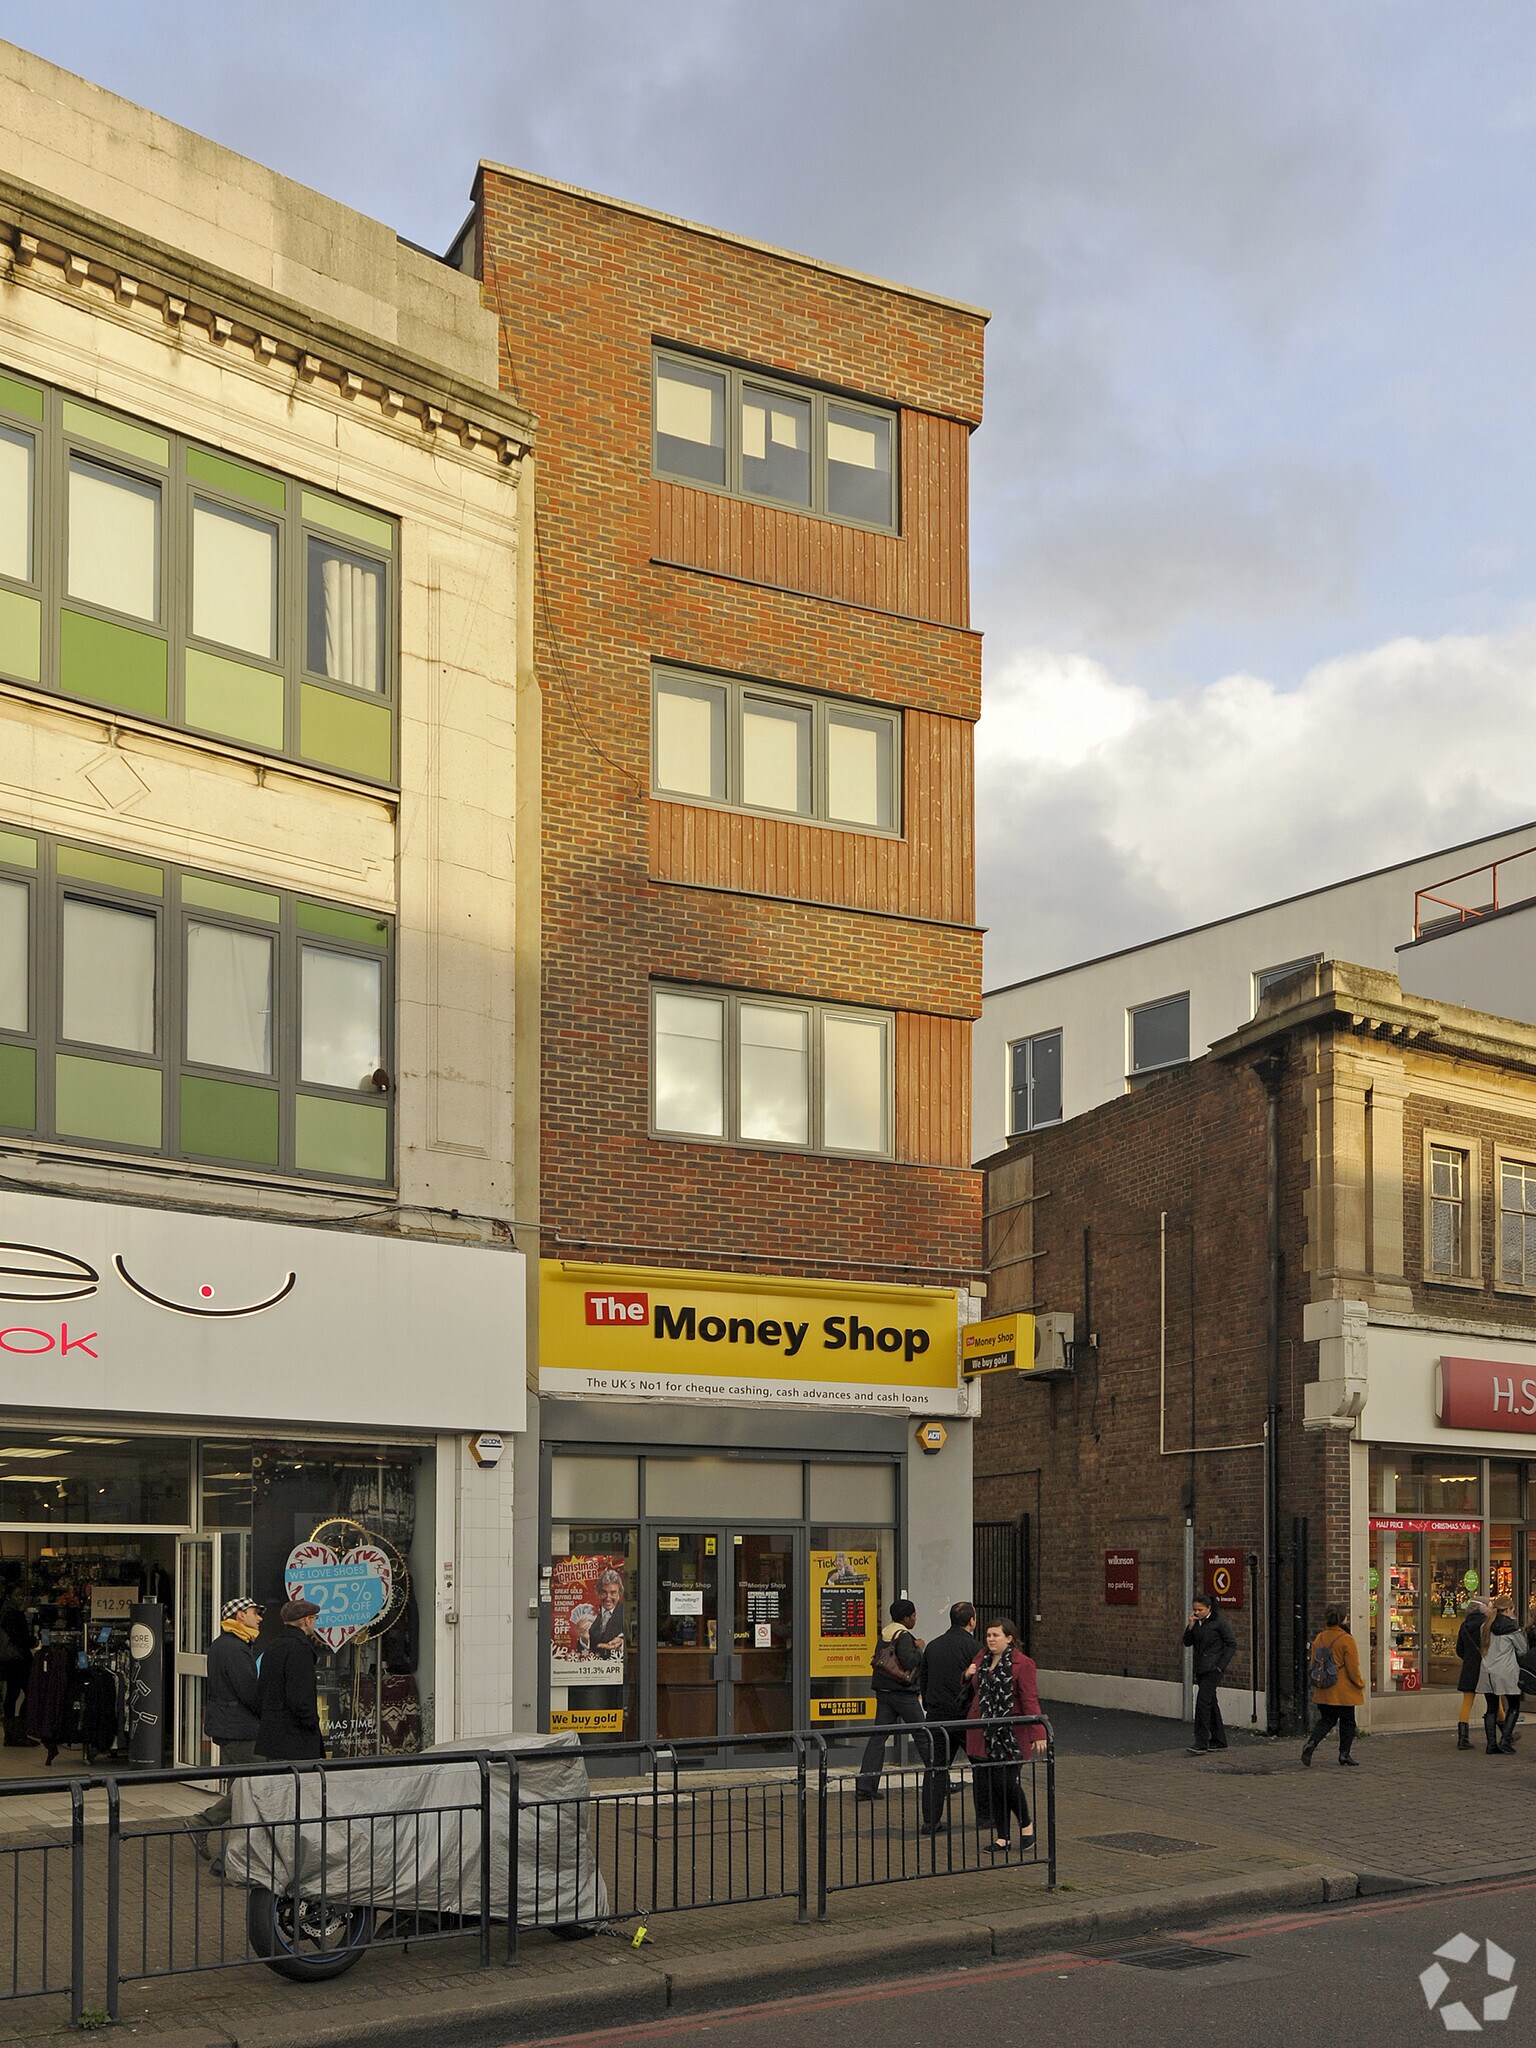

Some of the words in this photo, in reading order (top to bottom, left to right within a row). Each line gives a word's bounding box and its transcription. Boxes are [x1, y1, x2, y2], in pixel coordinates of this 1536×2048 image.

[591, 1297, 645, 1320] The
[655, 1305, 809, 1356] Money
[823, 1316, 930, 1362] Shop
[975, 1337, 996, 1347] Money
[998, 1333, 1014, 1343] Shop
[972, 1360, 981, 1369] We
[982, 1358, 993, 1368] buy
[994, 1354, 1007, 1367] gold
[587, 1378, 607, 1388] The
[640, 1380, 661, 1391] No1
[666, 1381, 682, 1391] for
[686, 1382, 726, 1395] cheque
[729, 1385, 772, 1398] cashing,
[776, 1387, 799, 1397] cash
[803, 1388, 851, 1400] advances
[854, 1391, 874, 1401] and
[877, 1392, 899, 1402] cash
[902, 1394, 929, 1404] loans
[928, 1430, 941, 1440] ADT
[1432, 1522, 1459, 1530] CHRISTMAS
[1108, 1556, 1134, 1565] wilkinson
[1209, 1555, 1236, 1565] wilkinson
[290, 1571, 305, 1579] WE
[308, 1568, 331, 1578] LOVE
[333, 1565, 365, 1576] SHOES
[556, 1561, 599, 1573] Christmas
[559, 1570, 598, 1582] CRACKER
[1115, 1581, 1134, 1591] parking
[310, 1581, 371, 1614] 25%
[97, 1599, 133, 1610] £12.99
[352, 1602, 371, 1611] OFF
[1444, 1599, 1454, 1607] 25
[326, 1612, 371, 1623] FOOTWEAR
[554, 1619, 570, 1627] 25%
[734, 1632, 750, 1640] push
[854, 1654, 861, 1662] in
[579, 1667, 605, 1675] 131.3%
[606, 1666, 621, 1674] APR
[350, 1719, 373, 1729] TIME
[552, 1714, 568, 1724] We
[571, 1714, 591, 1726] buy
[593, 1713, 618, 1725] gold
